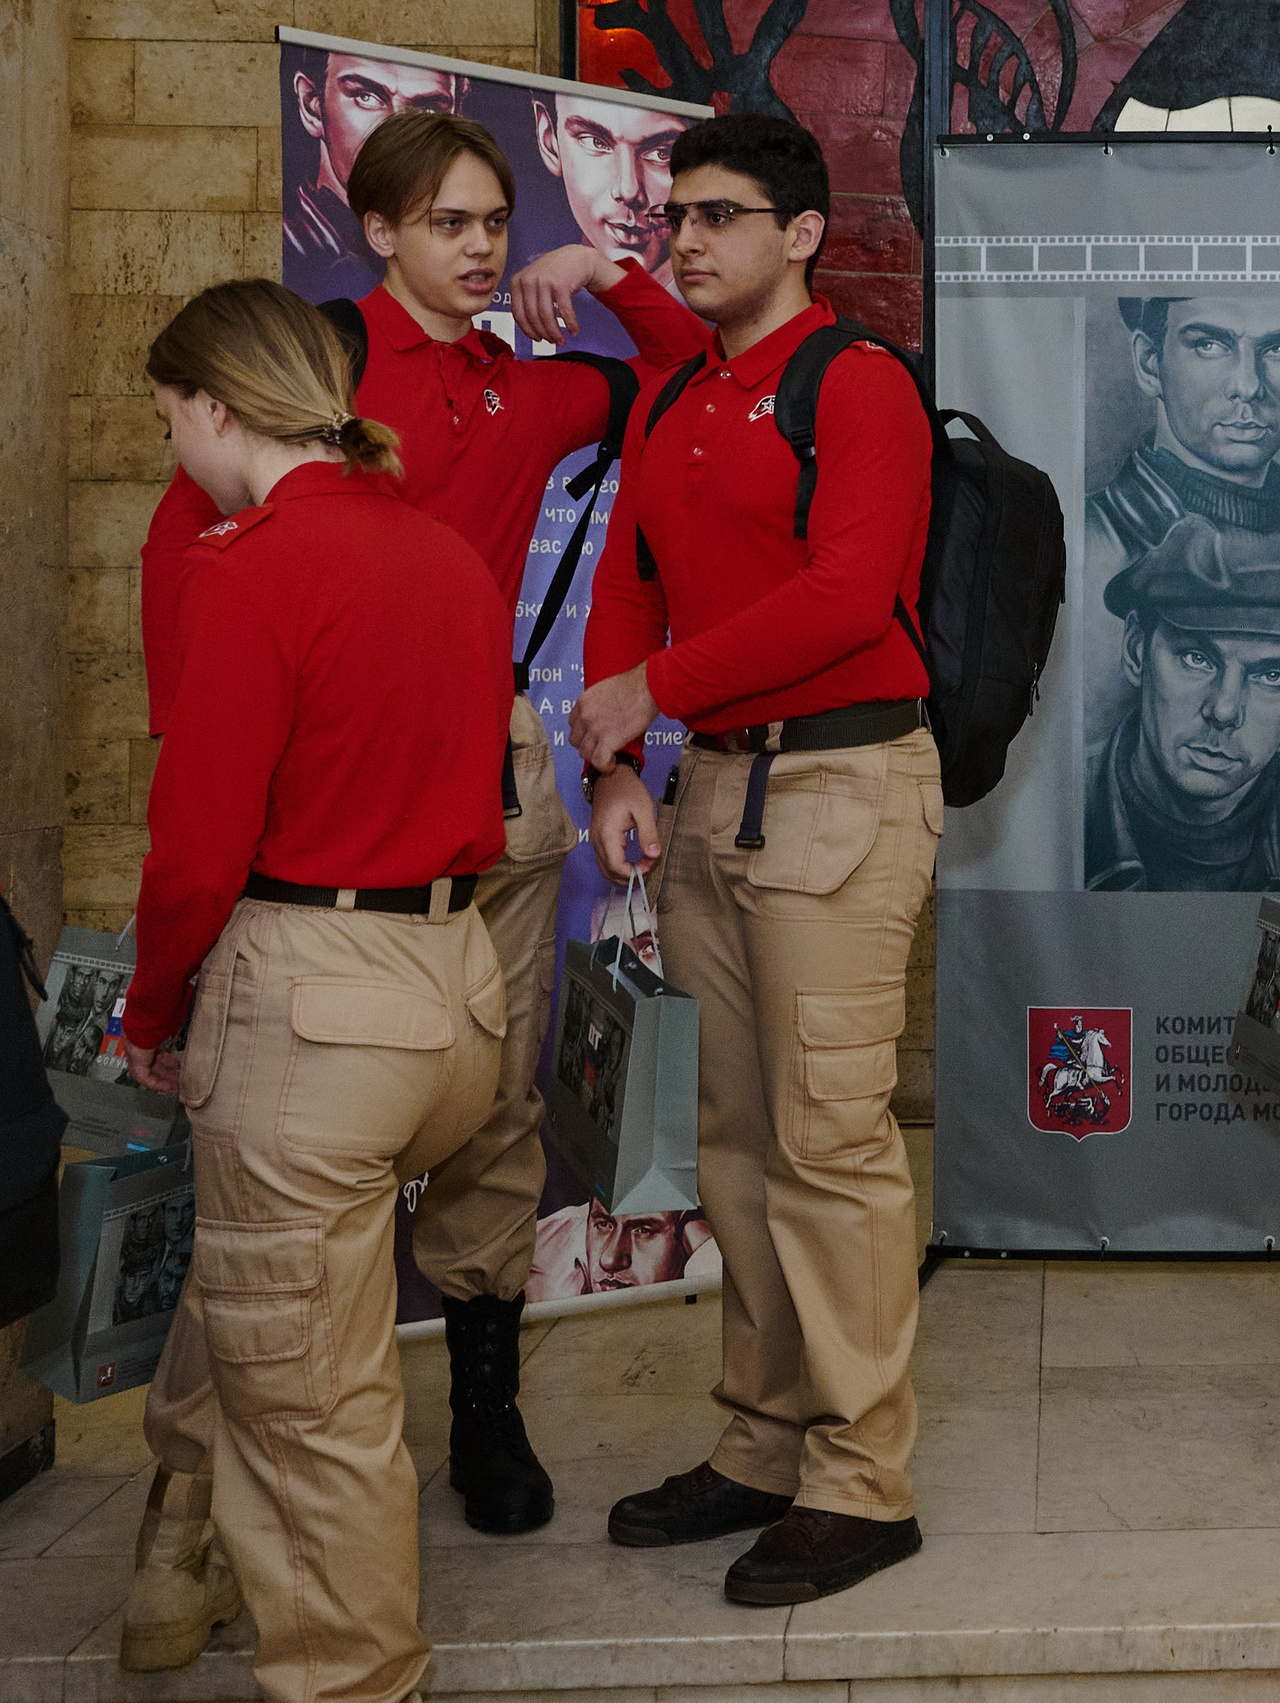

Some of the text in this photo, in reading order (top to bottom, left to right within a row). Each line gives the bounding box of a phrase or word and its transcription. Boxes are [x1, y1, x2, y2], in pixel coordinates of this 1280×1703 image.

[545, 507, 576, 523] что
[529, 668, 562, 682] лон
[644, 731, 684, 745] стие
[1156, 1016, 1236, 1035] КОМИТ
[1155, 1045, 1225, 1067] ОБЩЕ
[1155, 1074, 1170, 1092] И
[1178, 1074, 1266, 1096] МОЛОД
[1155, 1103, 1246, 1125] ГОРОДА
